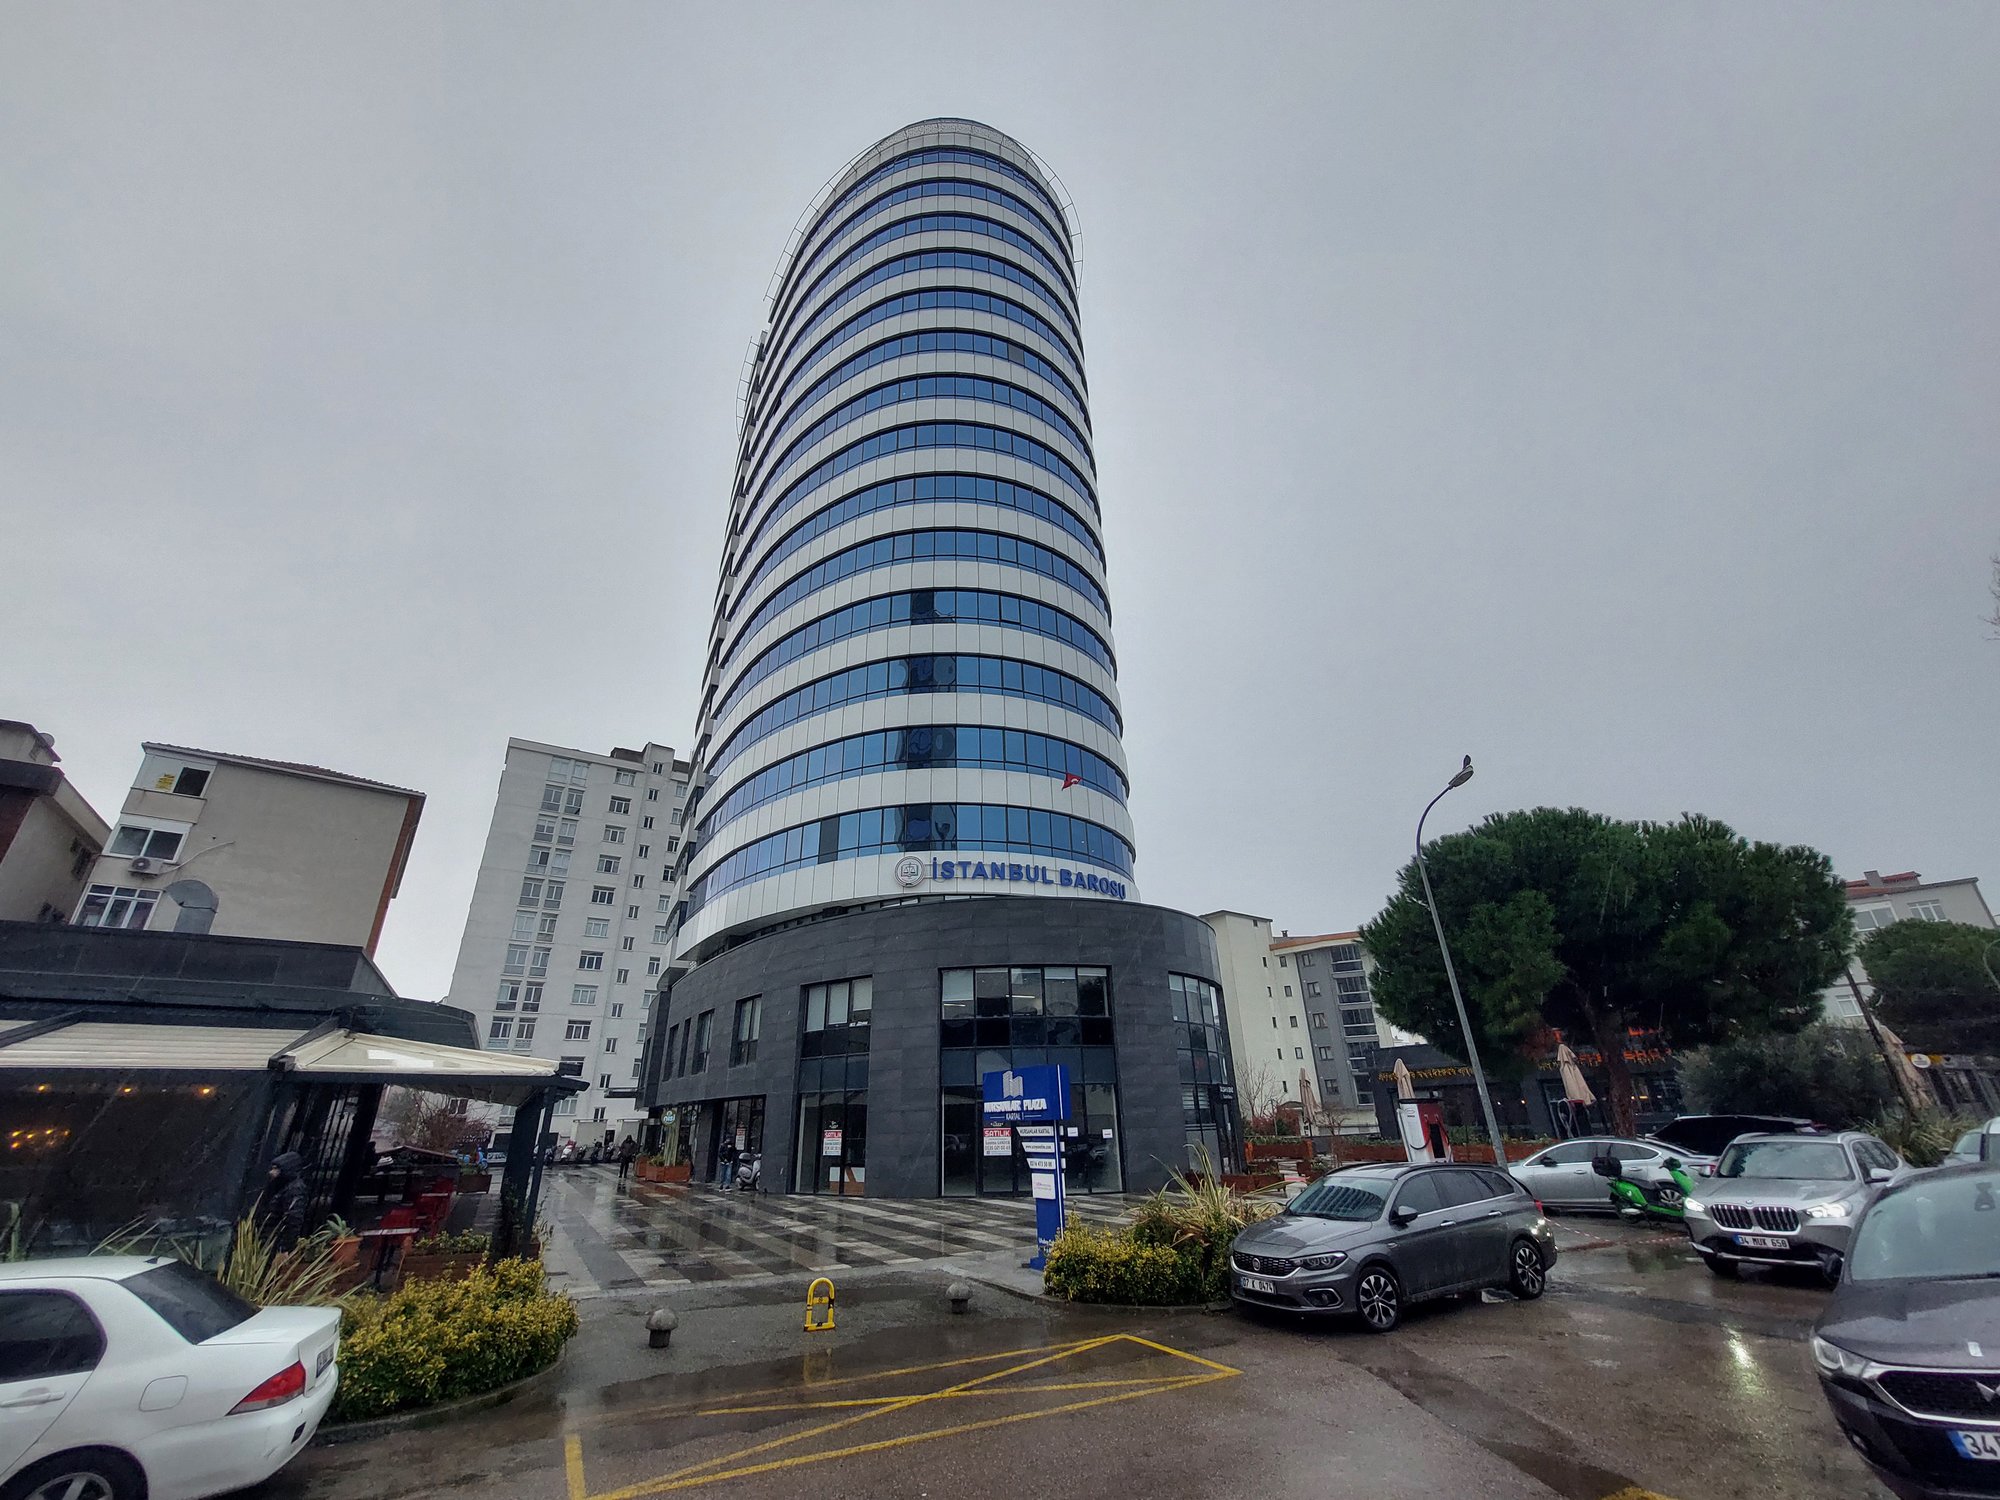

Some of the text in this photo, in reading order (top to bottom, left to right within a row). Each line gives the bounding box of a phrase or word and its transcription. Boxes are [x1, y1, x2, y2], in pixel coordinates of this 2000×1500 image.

[932, 856, 1127, 900] İSTANBUL BAROSU
[1023, 1098, 1047, 1111] PLAZA
[1739, 1236, 1750, 1245] 34
[1963, 1434, 1998, 1457] 34
